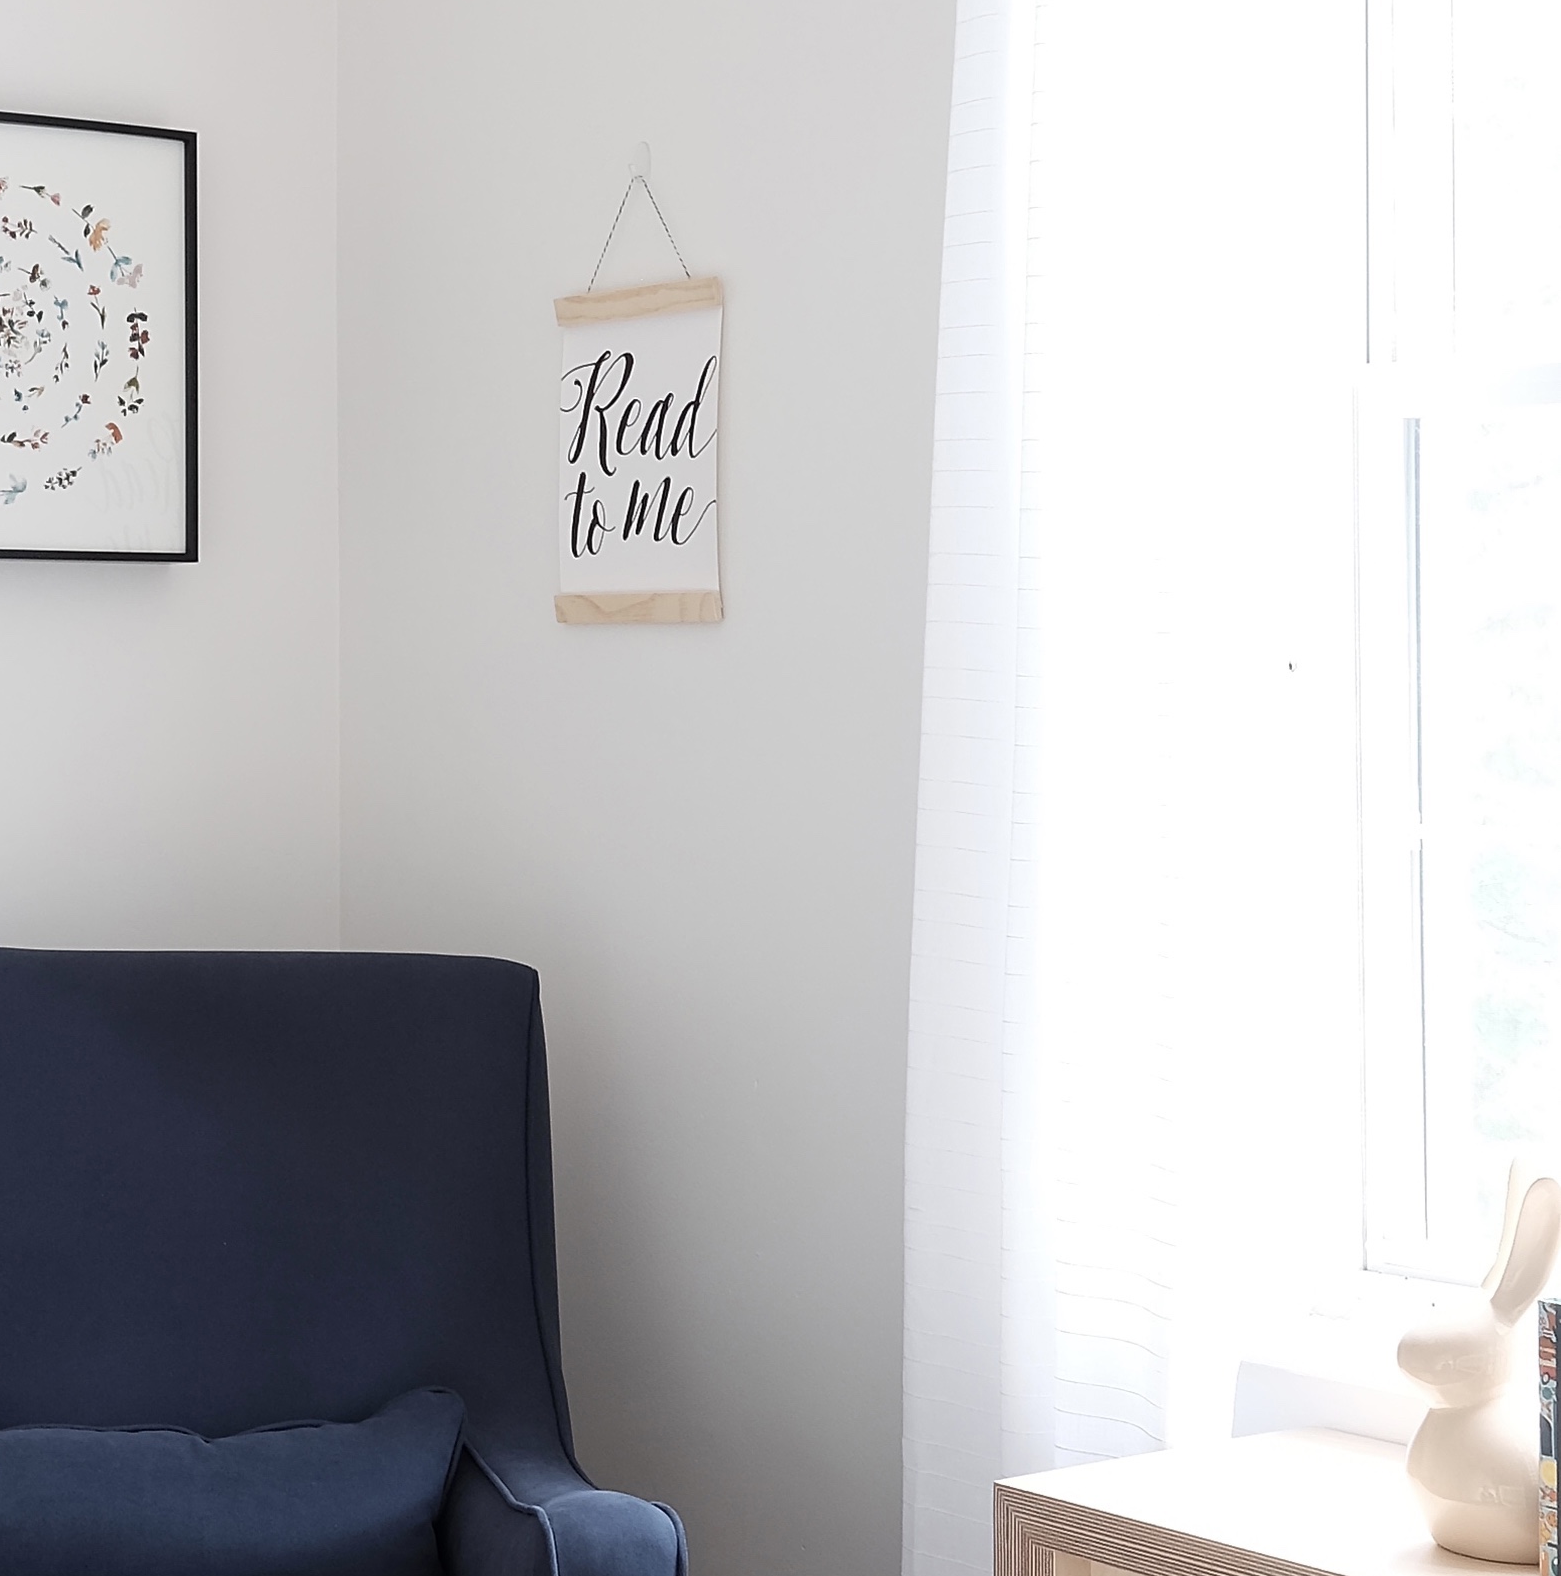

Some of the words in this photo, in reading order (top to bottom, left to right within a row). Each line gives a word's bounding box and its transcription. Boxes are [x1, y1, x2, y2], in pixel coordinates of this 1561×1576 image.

[560, 349, 718, 477] Read
[564, 471, 616, 559] to
[622, 475, 717, 546] me
